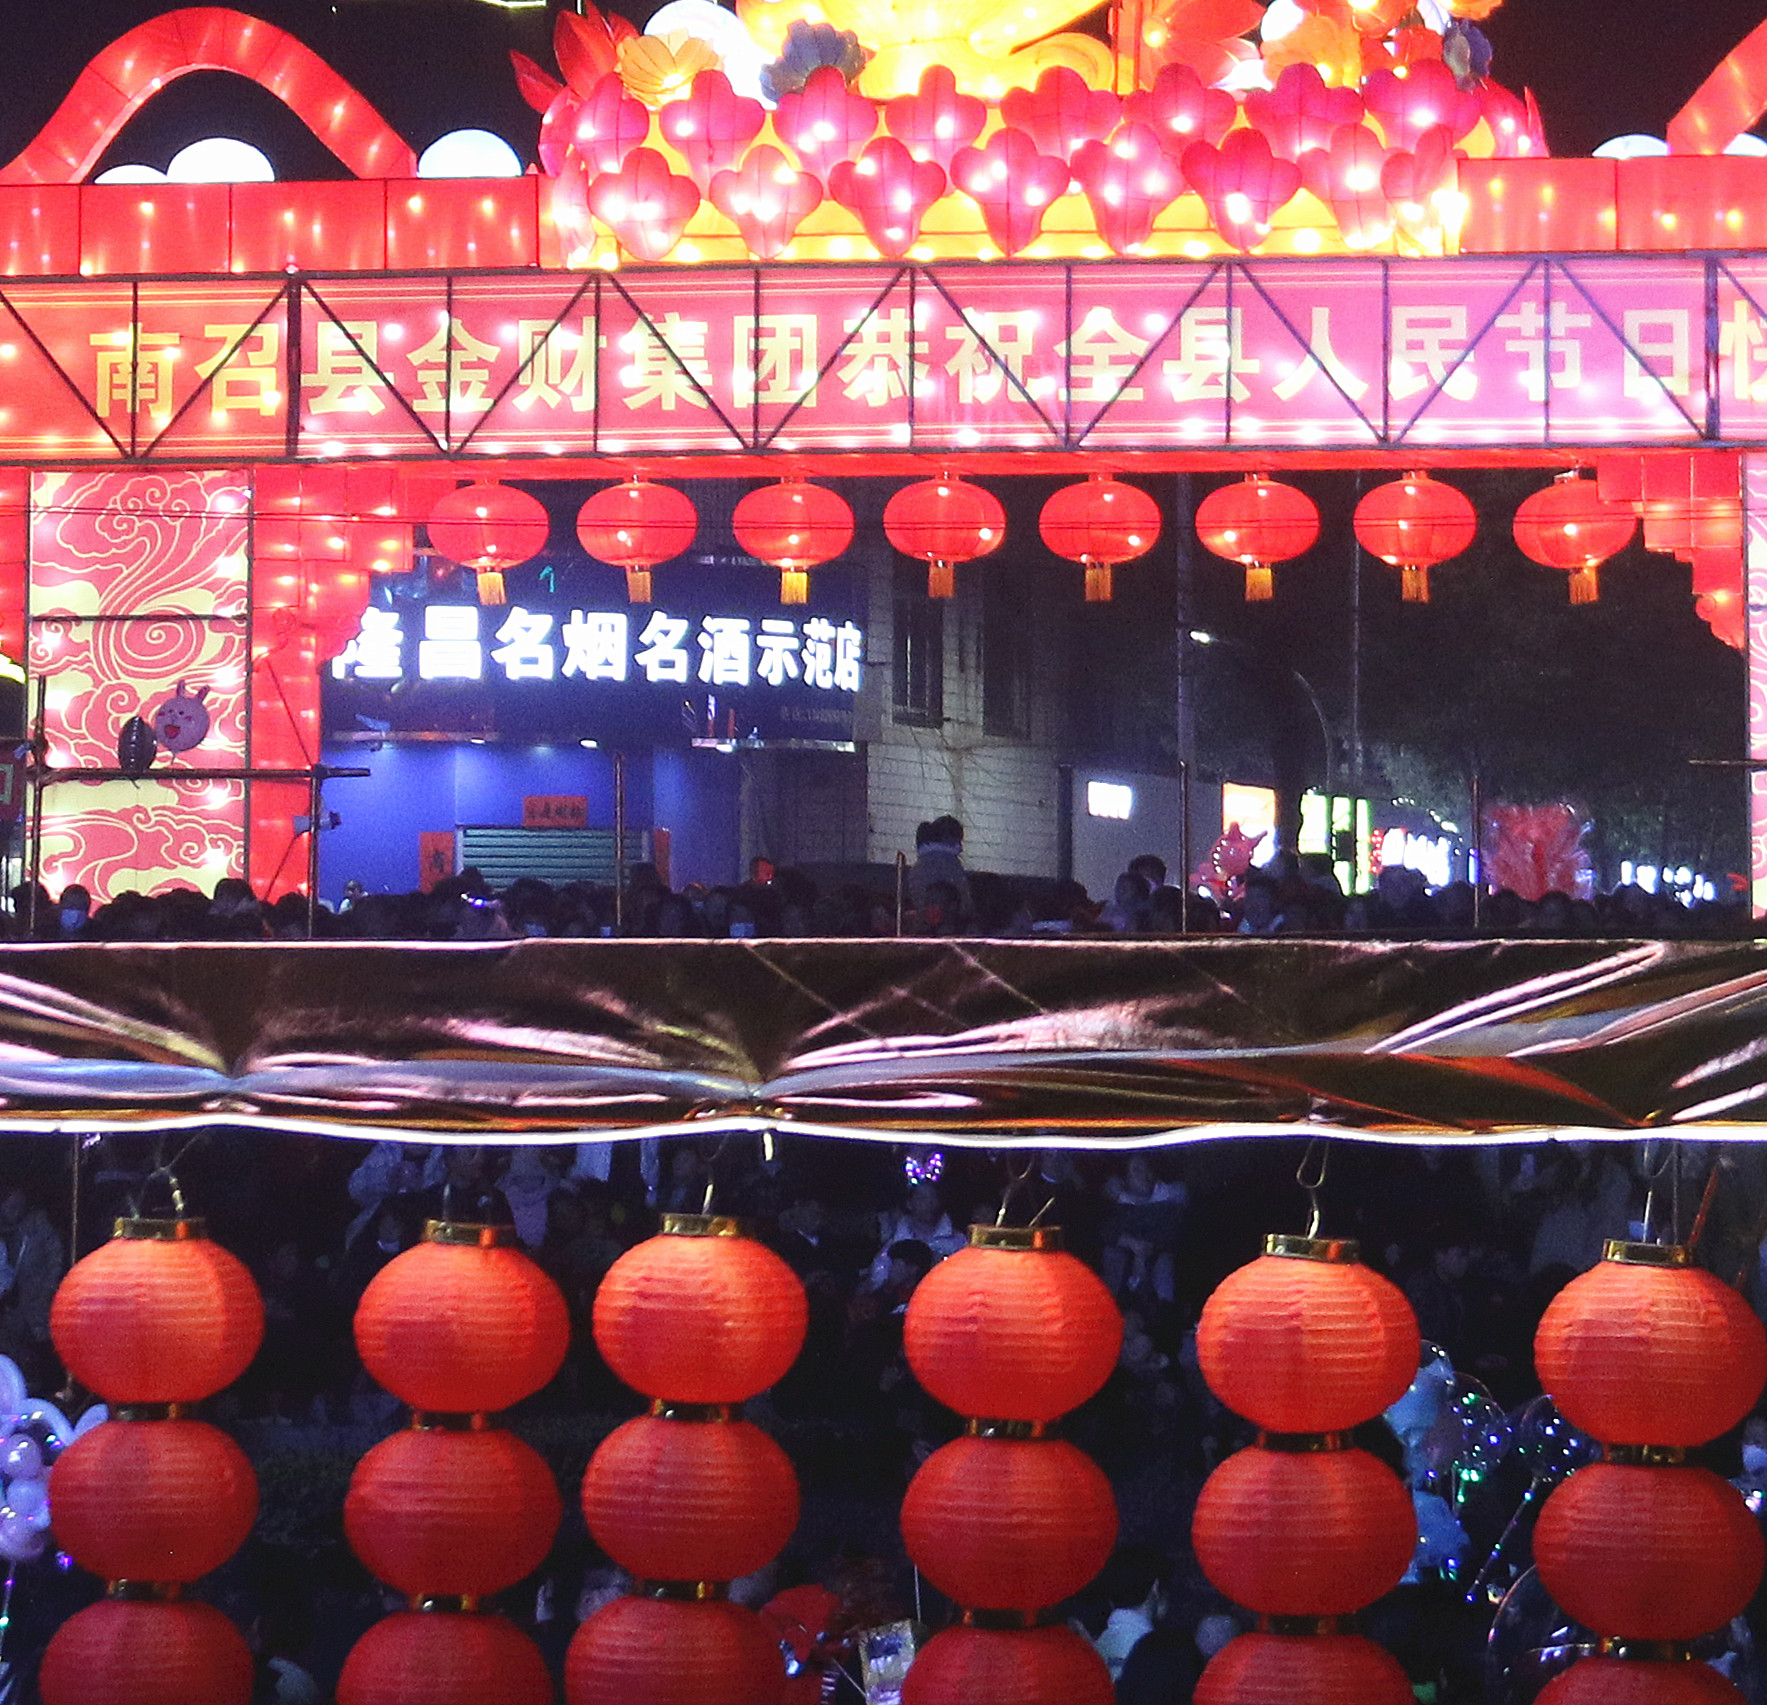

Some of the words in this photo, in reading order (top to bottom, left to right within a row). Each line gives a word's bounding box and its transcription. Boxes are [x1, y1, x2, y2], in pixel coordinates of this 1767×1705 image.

[333, 604, 862, 691] 隆昌名烟名酒示范店
